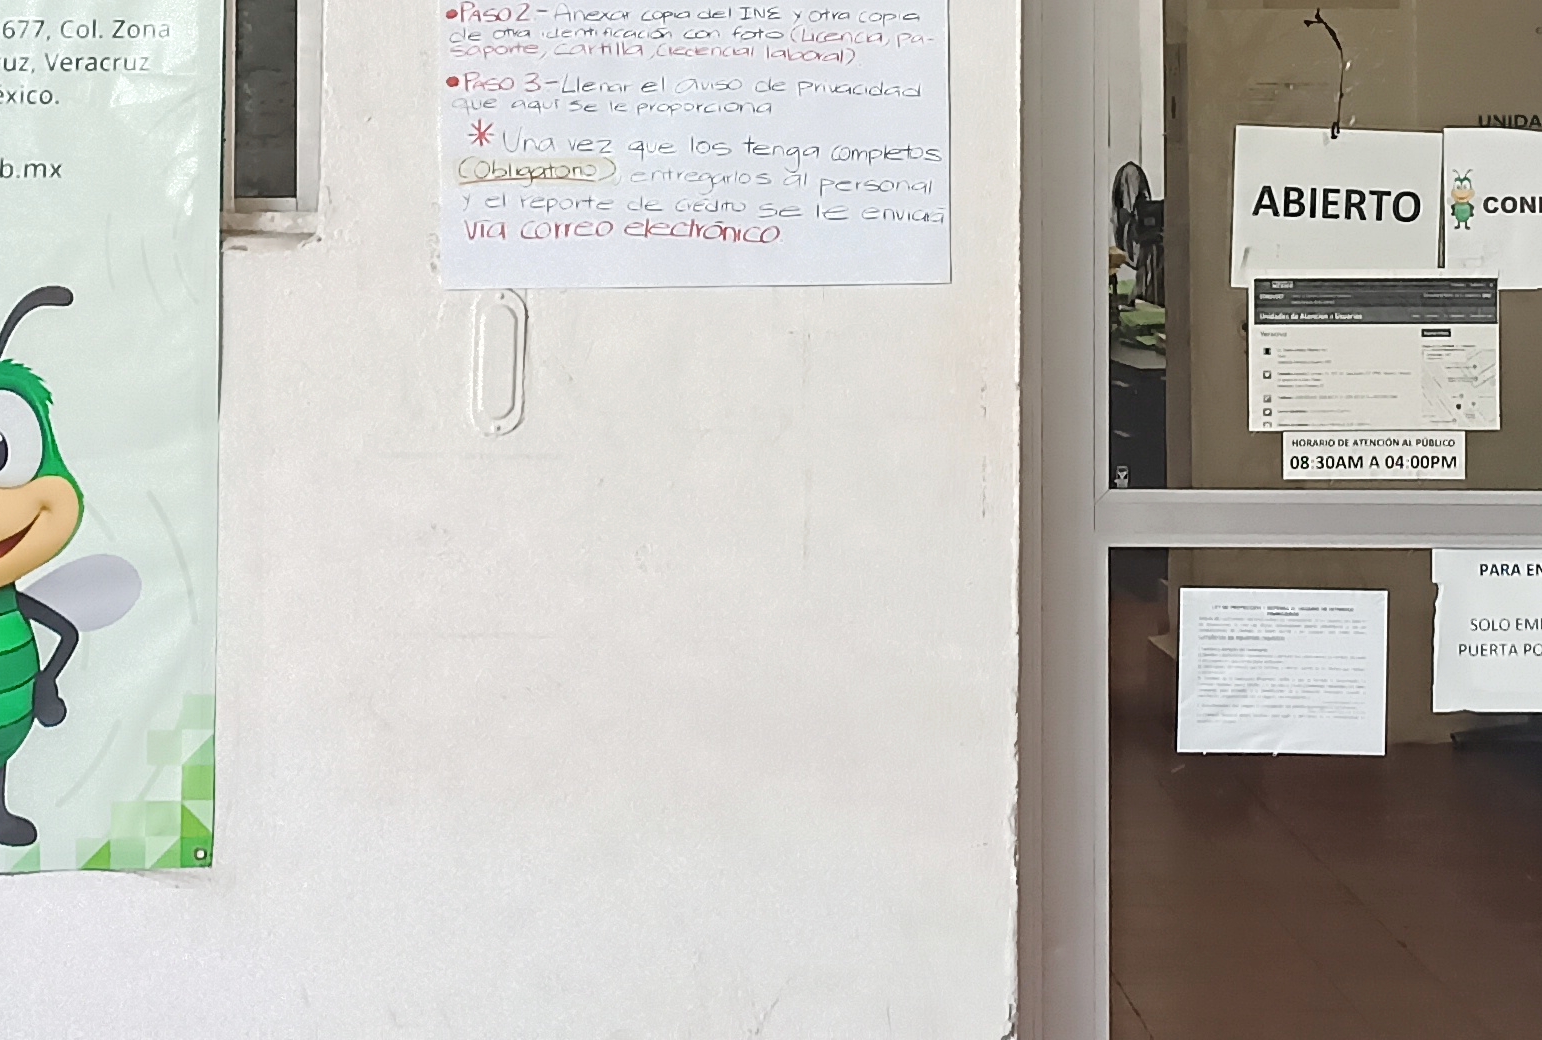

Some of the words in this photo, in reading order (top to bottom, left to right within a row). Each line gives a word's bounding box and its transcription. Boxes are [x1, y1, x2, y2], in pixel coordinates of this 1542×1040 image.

[61, 19, 103, 39] Col.
[112, 20, 170, 39] Zona
[45, 52, 149, 72] Veracruz
[504, 127, 555, 152] Una
[628, 140, 676, 161] que
[692, 136, 731, 156] los
[744, 135, 819, 173] tenga
[832, 144, 941, 165] completos
[521, 195, 613, 214] reporte
[1253, 185, 1421, 222] ABIERTO
[1292, 439, 1335, 447] HORARIO
[1338, 439, 1349, 447] DE
[1353, 437, 1399, 447] ATENCIÓN
[1402, 439, 1412, 447] AL
[1416, 437, 1455, 447] PÚBLICO
[1290, 456, 1363, 470] 08:30AM
[1370, 456, 1379, 469] A
[1385, 456, 1457, 469] 04:00PM
[1479, 564, 1521, 576] PARA
[1470, 618, 1510, 631] SOLO
[1459, 643, 1518, 657] PUERTA
